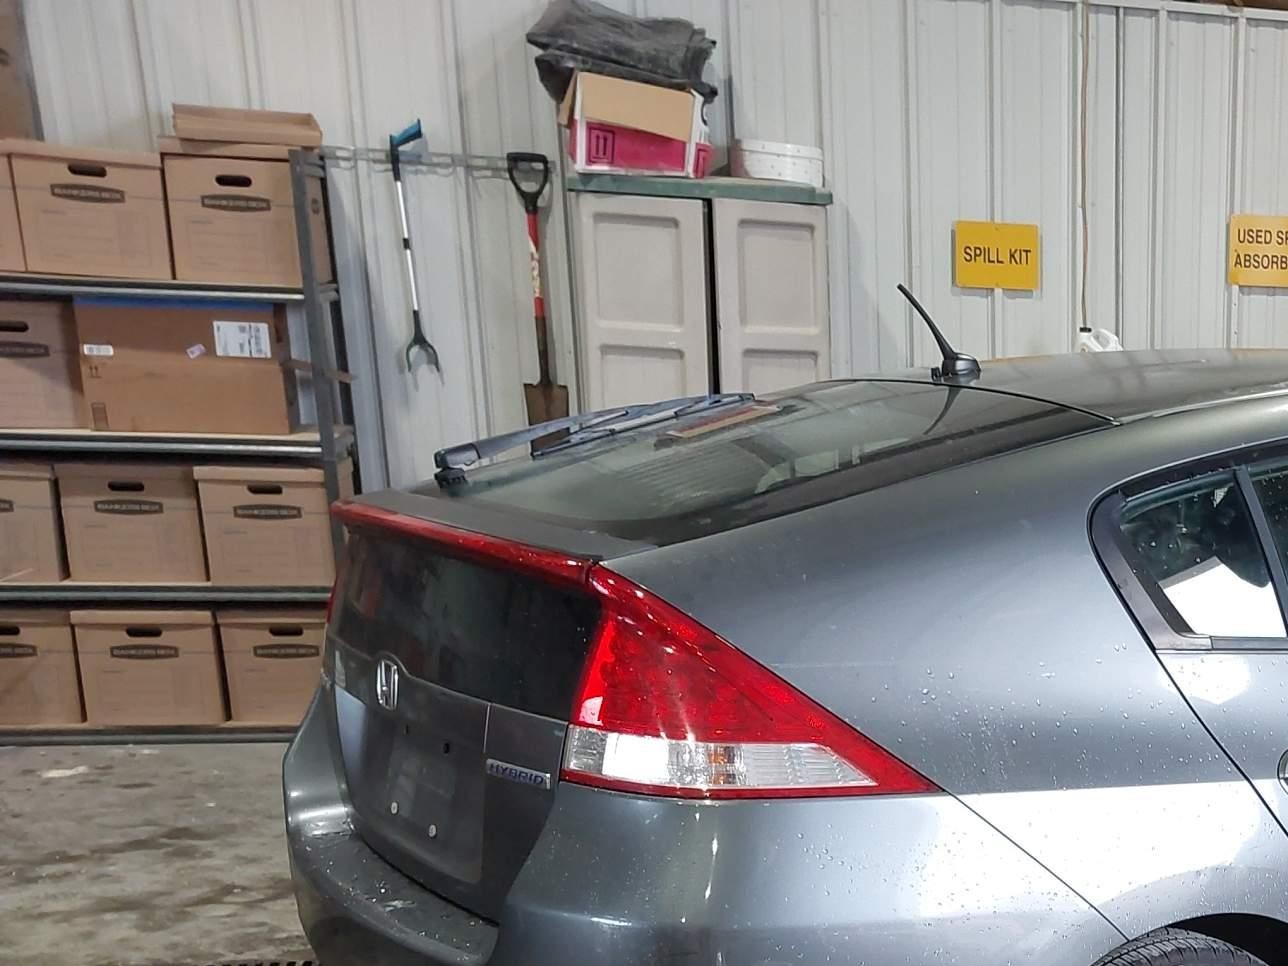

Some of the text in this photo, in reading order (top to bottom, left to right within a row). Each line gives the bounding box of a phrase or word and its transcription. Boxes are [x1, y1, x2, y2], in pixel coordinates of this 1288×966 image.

[1237, 228, 1272, 245] USED
[963, 245, 1032, 265] SPILL KIT
[489, 762, 544, 785] HYBRID
